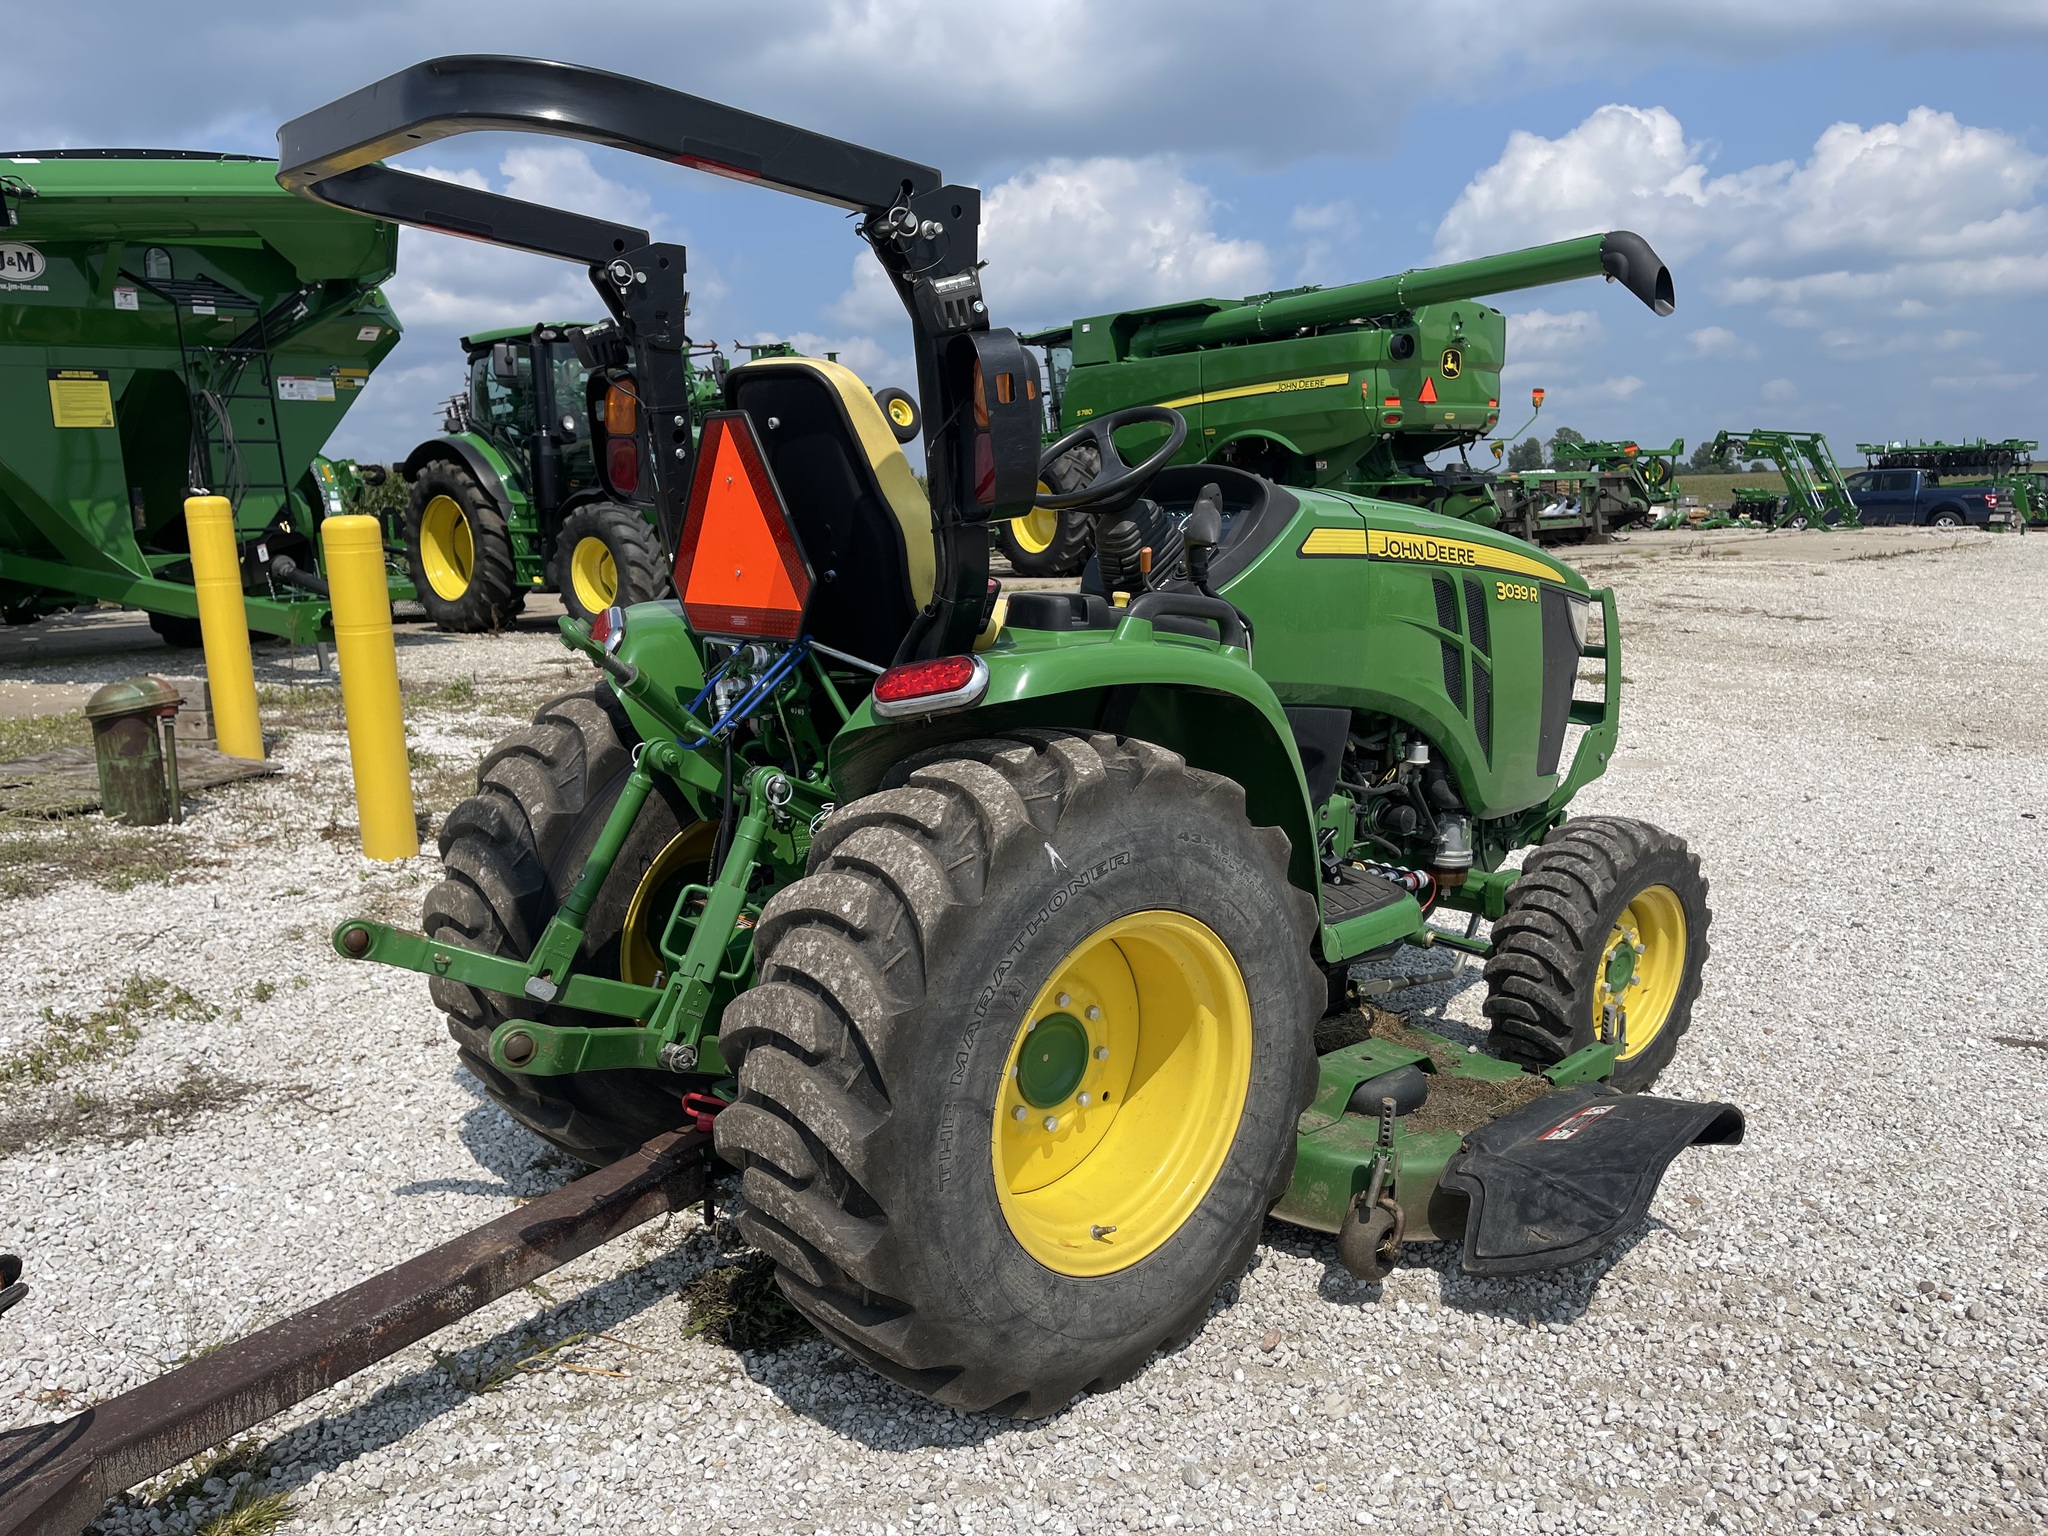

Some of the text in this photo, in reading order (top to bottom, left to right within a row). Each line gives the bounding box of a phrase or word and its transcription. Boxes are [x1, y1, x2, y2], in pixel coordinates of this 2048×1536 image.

[1276, 379, 1325, 392] JOHN DEERE
[1379, 536, 1475, 564] JOHN DEERE
[1495, 581, 1538, 603] 3039 R
[939, 851, 1131, 1192] THE MARATHONER
